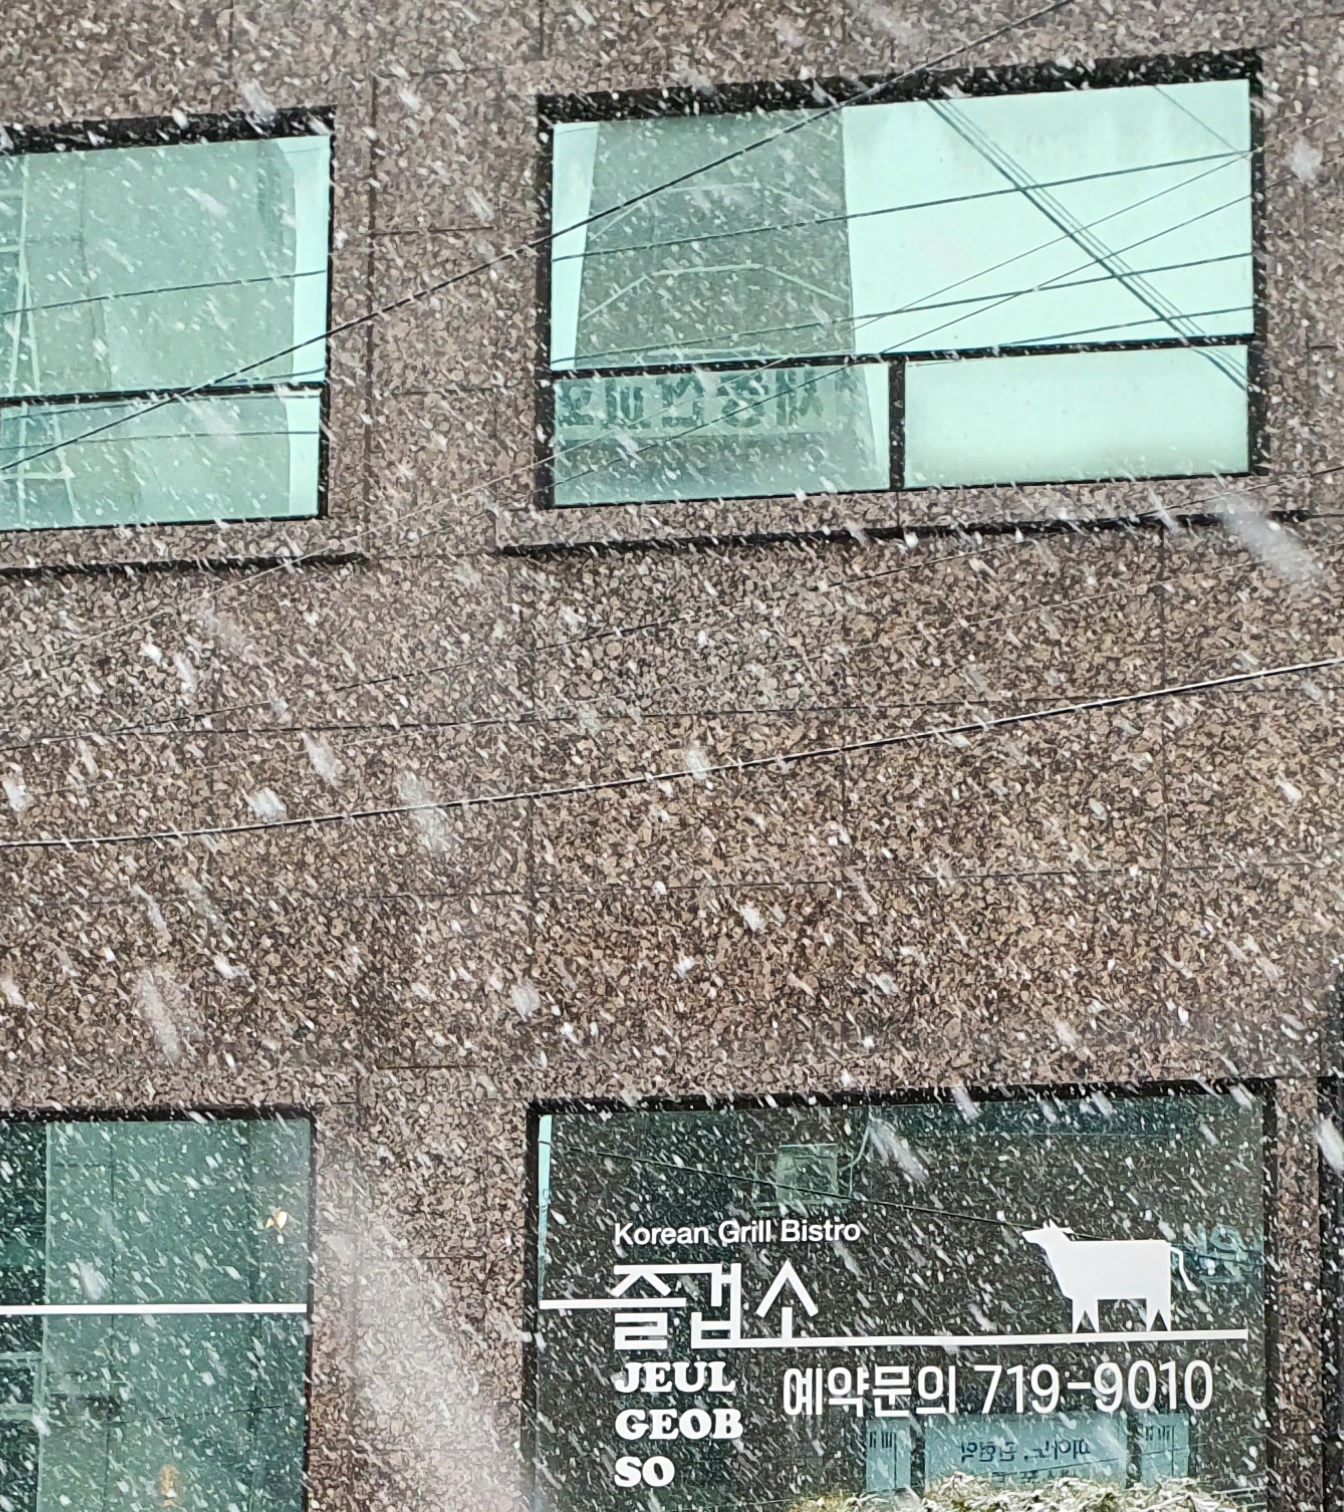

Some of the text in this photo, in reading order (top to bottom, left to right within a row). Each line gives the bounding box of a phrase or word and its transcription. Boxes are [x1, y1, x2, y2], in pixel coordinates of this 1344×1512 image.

[614, 1217, 861, 1247] Korean Grill Bistro
[612, 1261, 819, 1351] 즐겁소
[614, 1360, 737, 1395] JEUL
[782, 1359, 1214, 1418] 예약문의 719-9010
[614, 1408, 743, 1442] GEOB
[613, 1455, 676, 1489] SO
